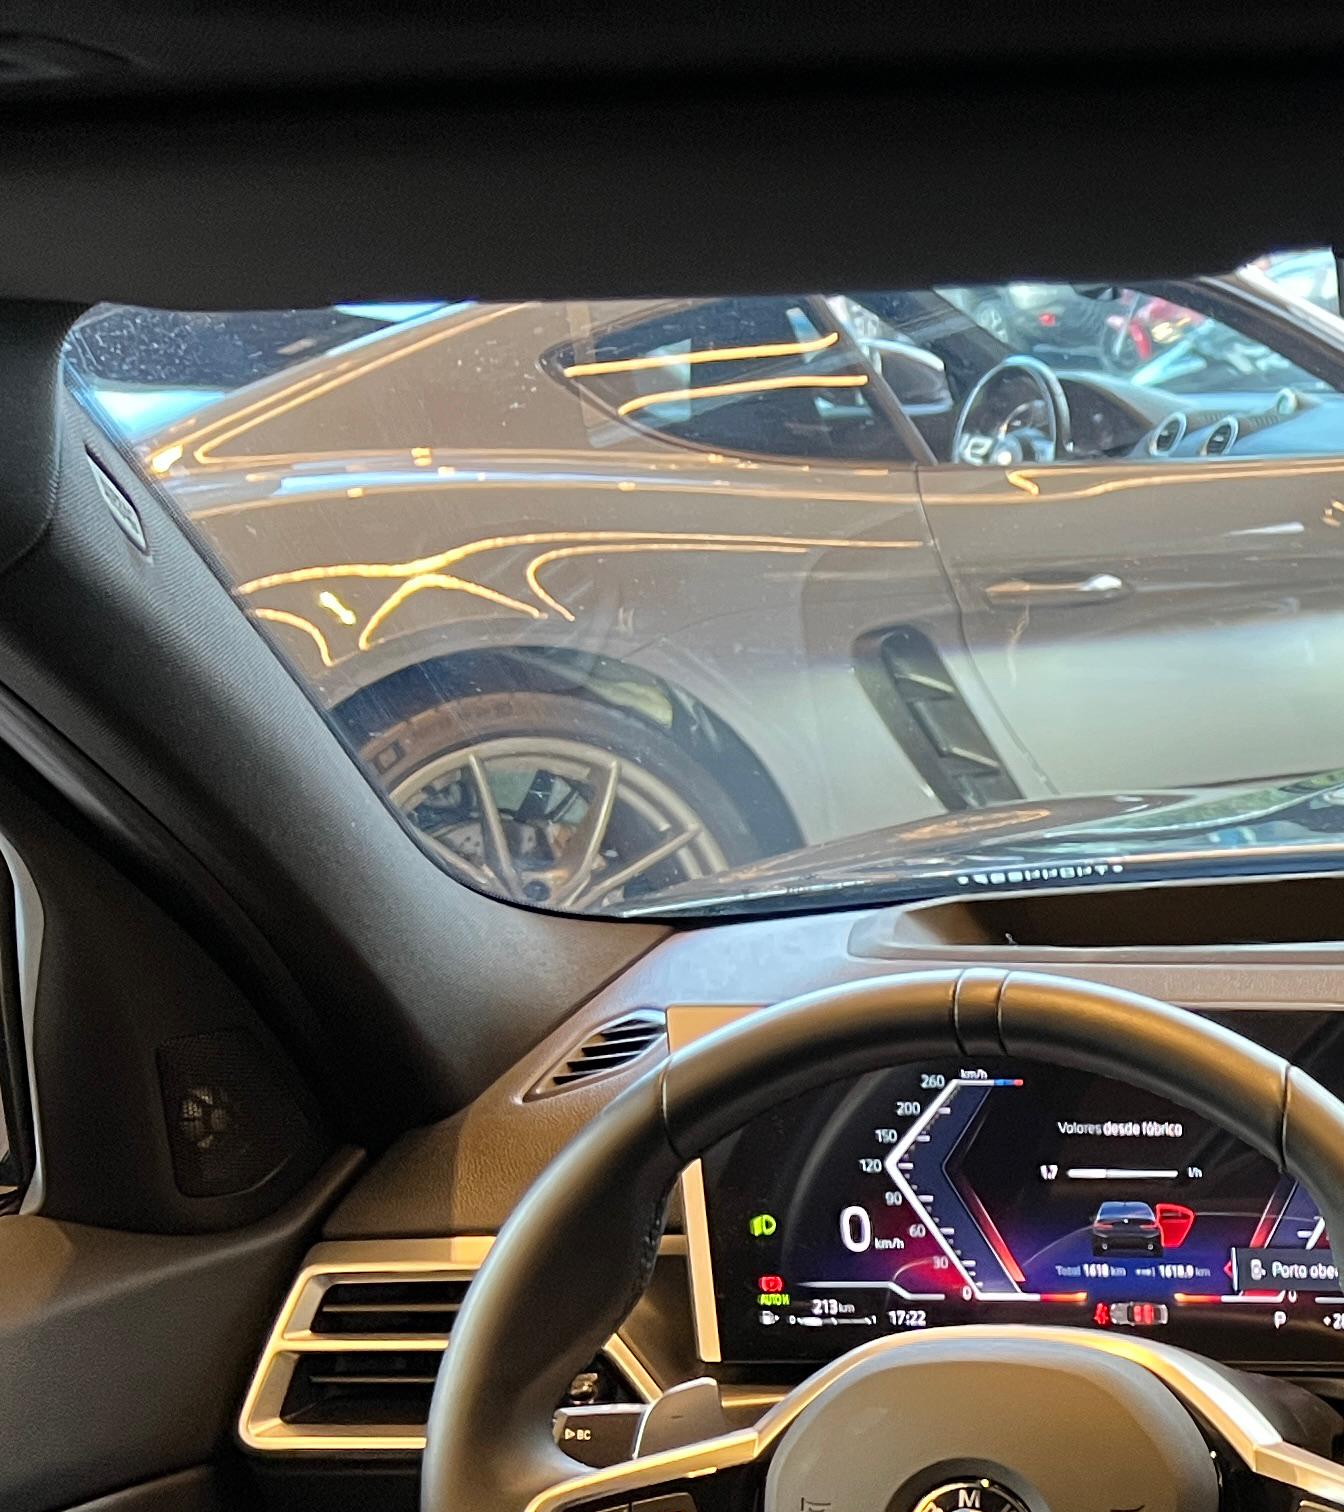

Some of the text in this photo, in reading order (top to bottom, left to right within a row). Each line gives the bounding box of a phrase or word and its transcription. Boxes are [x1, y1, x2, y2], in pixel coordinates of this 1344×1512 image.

[920, 1074, 945, 1089] 260
[960, 1069, 987, 1079] km/h
[896, 1101, 920, 1116] 200
[875, 1129, 897, 1143] 150
[1103, 1120, 1140, 1137] desde
[859, 1159, 882, 1173] 120
[884, 1191, 902, 1206] 90
[840, 1205, 904, 1252] 0 km/h
[909, 1224, 926, 1238] 60
[1110, 1265, 1126, 1277] km
[1272, 1260, 1307, 1279] Porta
[811, 1299, 855, 1315] 213 km
[888, 1310, 926, 1327] 17:22
[1274, 1310, 1287, 1329] P
